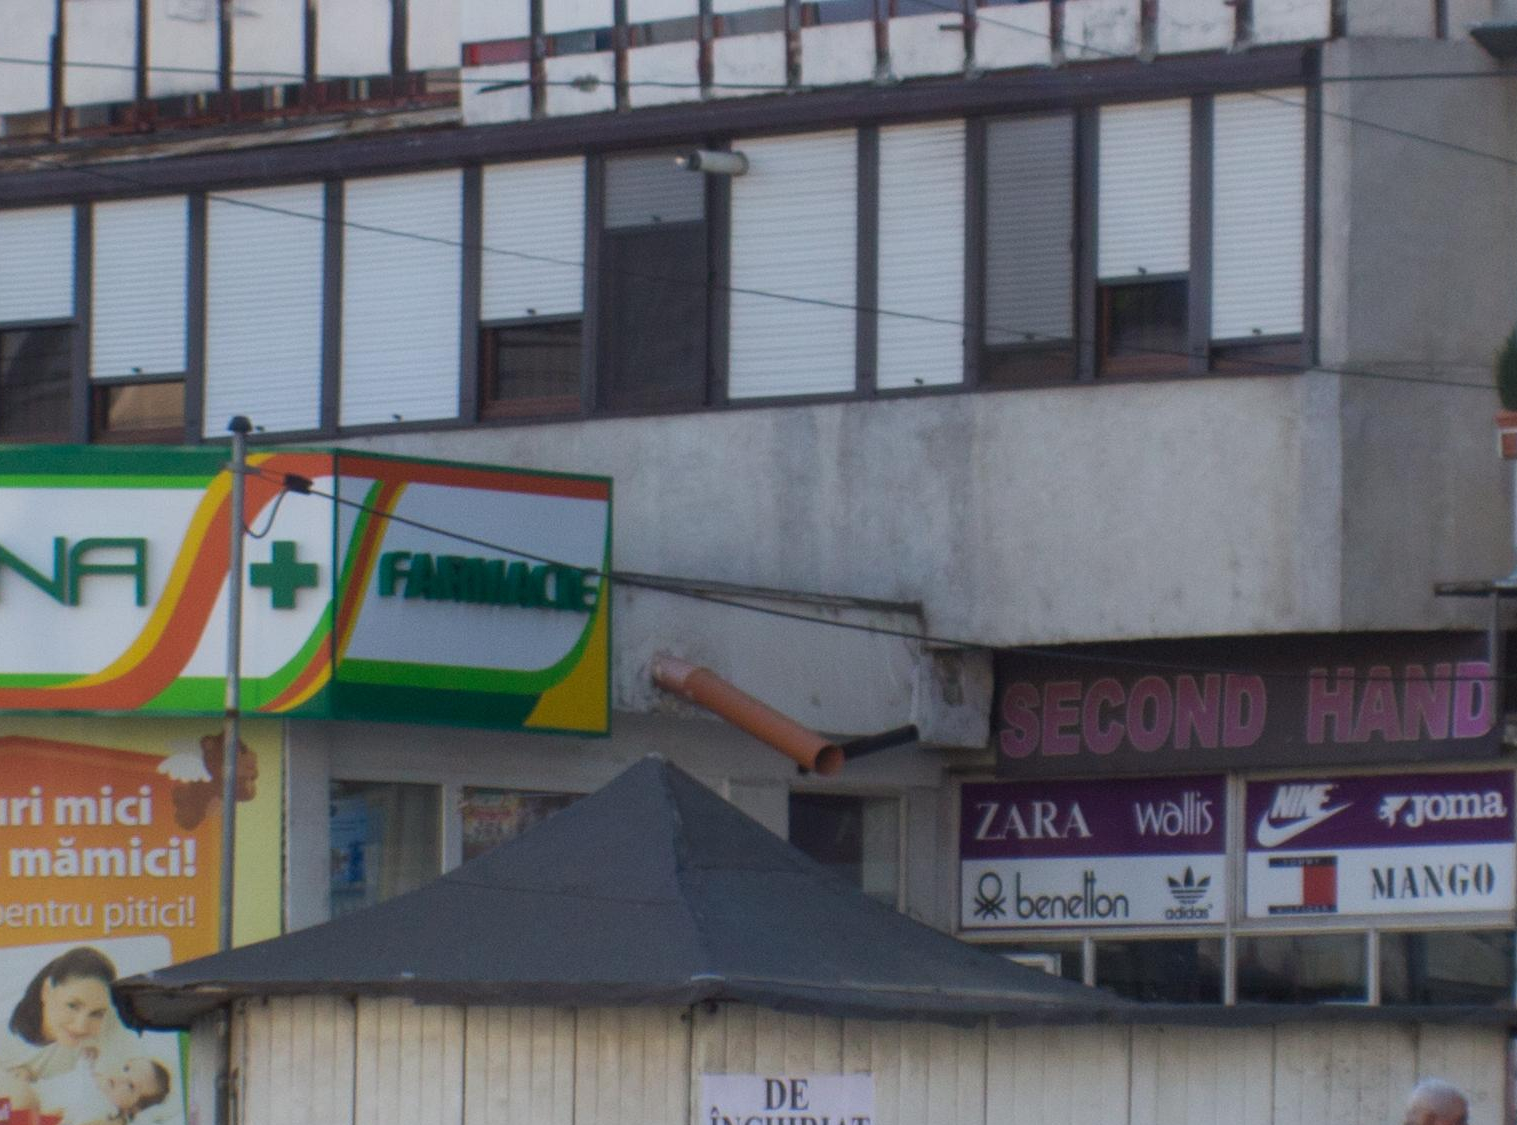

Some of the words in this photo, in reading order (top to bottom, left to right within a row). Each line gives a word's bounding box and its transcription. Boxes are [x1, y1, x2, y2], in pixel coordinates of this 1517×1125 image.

[378, 551, 599, 614] FARMACIE
[1000, 673, 1267, 758] SECOND
[1306, 661, 1493, 744] HAND
[54, 785, 153, 827] mici
[974, 801, 1092, 840] ZARA
[1269, 784, 1334, 819] NIKE
[9, 836, 198, 878] mămici!
[103, 895, 197, 935] pitici!
[1016, 867, 1129, 919] benetton
[1164, 904, 1211, 921] adidas
[1372, 862, 1496, 900] MANGO
[765, 1078, 809, 1111] DE
